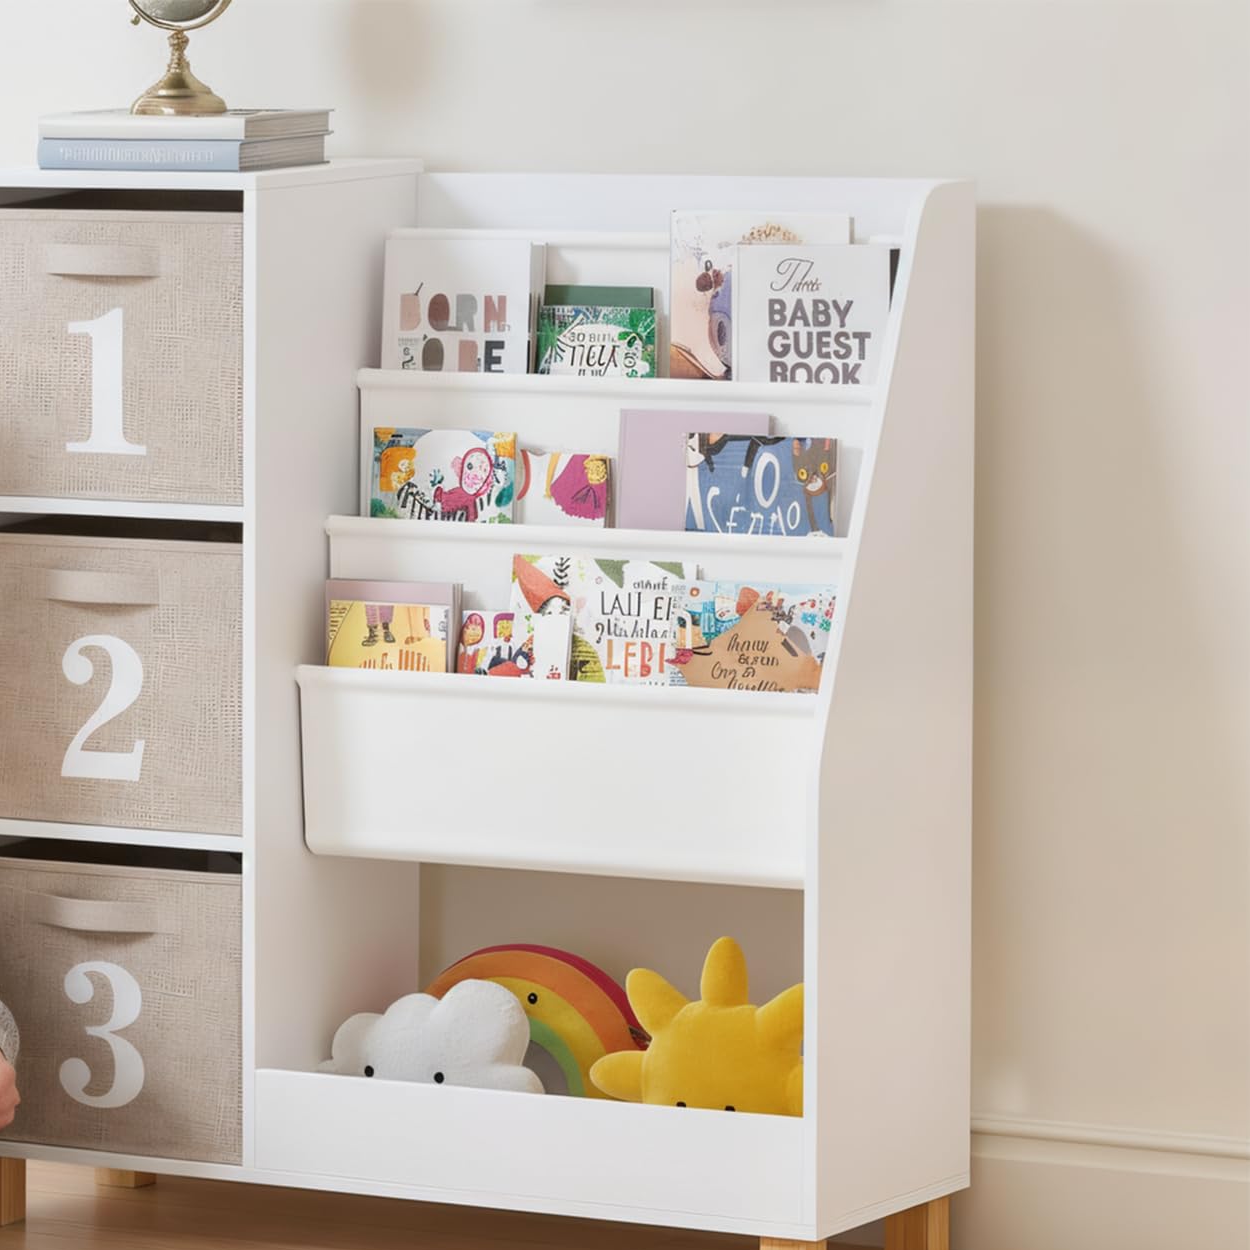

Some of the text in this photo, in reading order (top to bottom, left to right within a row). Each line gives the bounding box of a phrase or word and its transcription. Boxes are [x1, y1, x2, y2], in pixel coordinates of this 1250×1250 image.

[66, 307, 147, 455] 1
[768, 298, 854, 328] BABY
[768, 330, 871, 360] GUEST
[61, 634, 145, 781] 2
[59, 961, 145, 1108] 3
